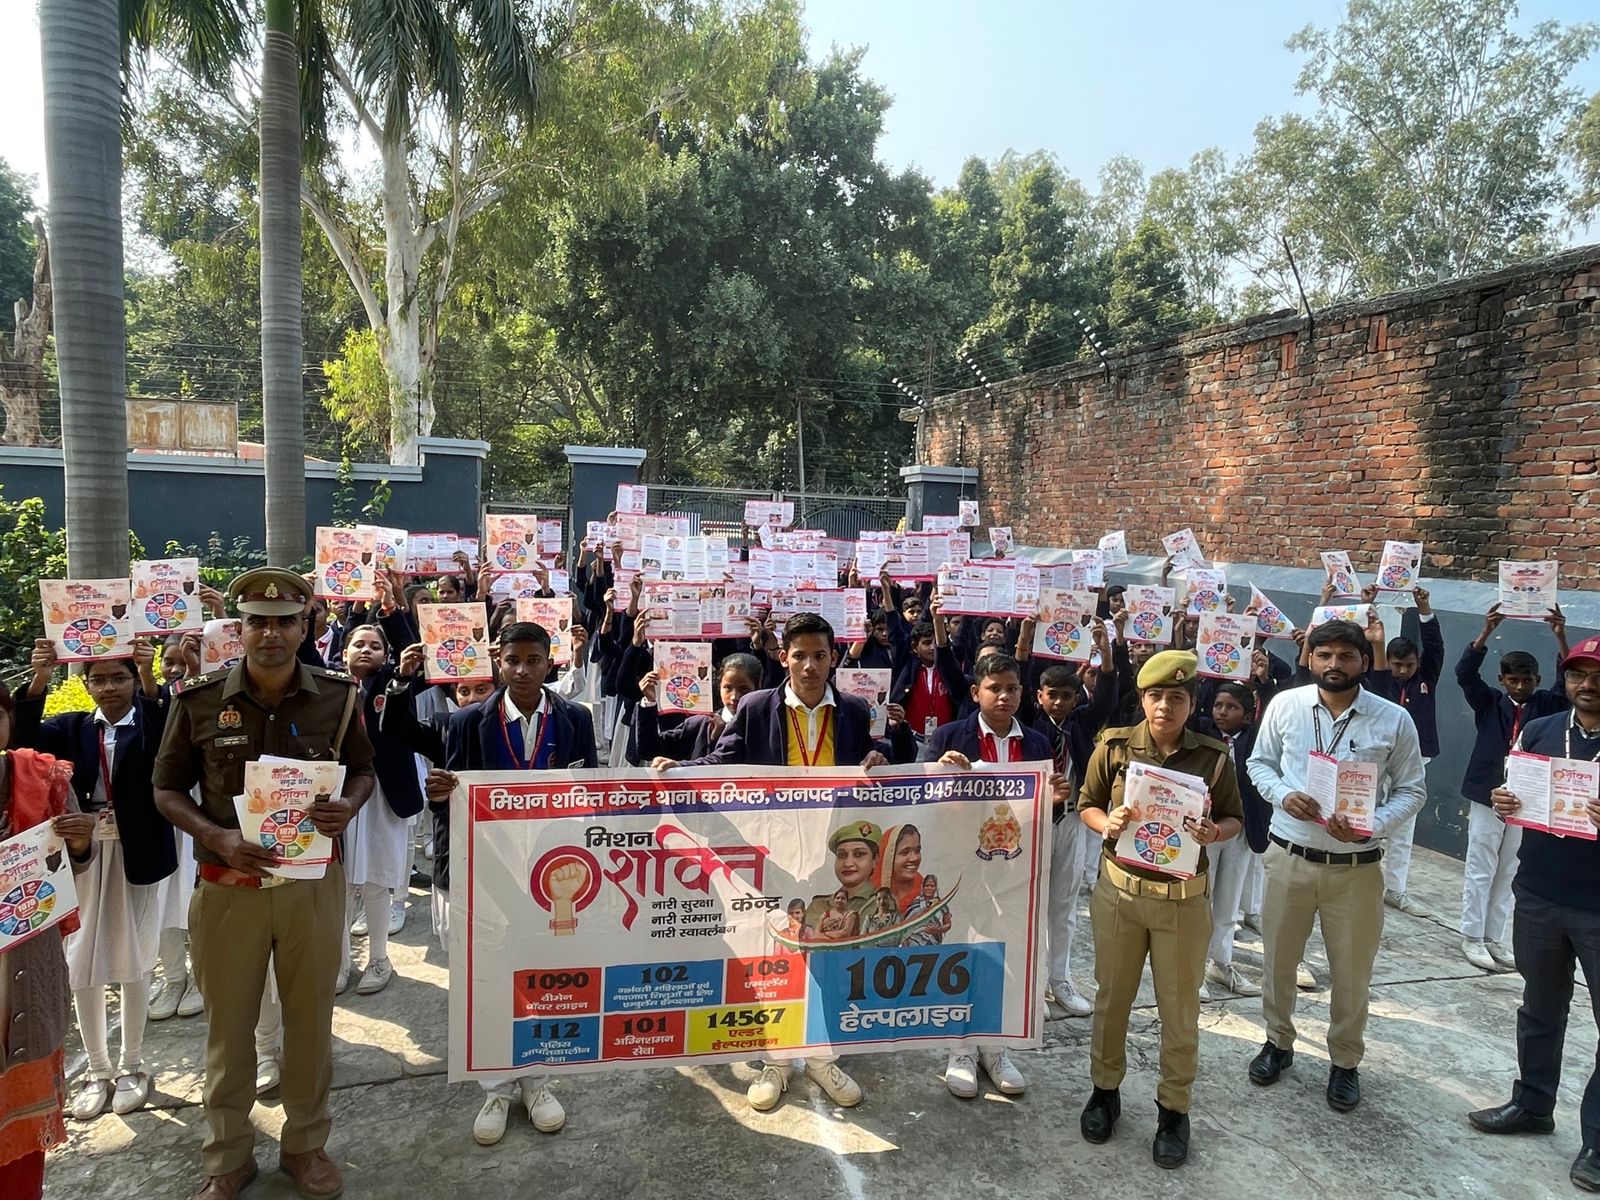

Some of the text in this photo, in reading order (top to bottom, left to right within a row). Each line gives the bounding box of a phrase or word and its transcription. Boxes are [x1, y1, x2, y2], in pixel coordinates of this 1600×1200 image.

[490, 788, 547, 811] मिशन
[552, 785, 604, 810] शक्ति
[608, 784, 653, 809] केन्द्र
[656, 789, 696, 806] थाना
[701, 783, 771, 805] कम्पिल,
[775, 786, 835, 804] जनपद
[853, 783, 922, 805] फतेहगढ़
[924, 779, 1026, 800] 9454403323
[584, 826, 654, 848] मिशन
[603, 824, 771, 932] शक्ति
[651, 897, 715, 913] नारी सुरक्षा
[731, 893, 782, 913] केन्द्र
[651, 912, 722, 925] नारी सम्मान
[650, 923, 738, 938] नारी स्वावलंबन
[640, 966, 688, 984] 102
[744, 960, 790, 978] 108
[846, 952, 970, 1001] 1076
[526, 972, 590, 990] 1090
[754, 990, 778, 1000] सेवा
[556, 1001, 588, 1010] लाइन
[622, 1016, 668, 1034] 101
[708, 1008, 786, 1029] 14567
[839, 1002, 974, 1032] हेल्पलाइन
[532, 1022, 582, 1039] 112
[728, 1027, 765, 1037] एल्डर
[540, 1040, 572, 1049] पुलिस
[613, 1034, 674, 1046] अग्निशमन
[712, 1038, 778, 1050] हेल्पलाइन
[632, 1046, 656, 1056] सेवा
